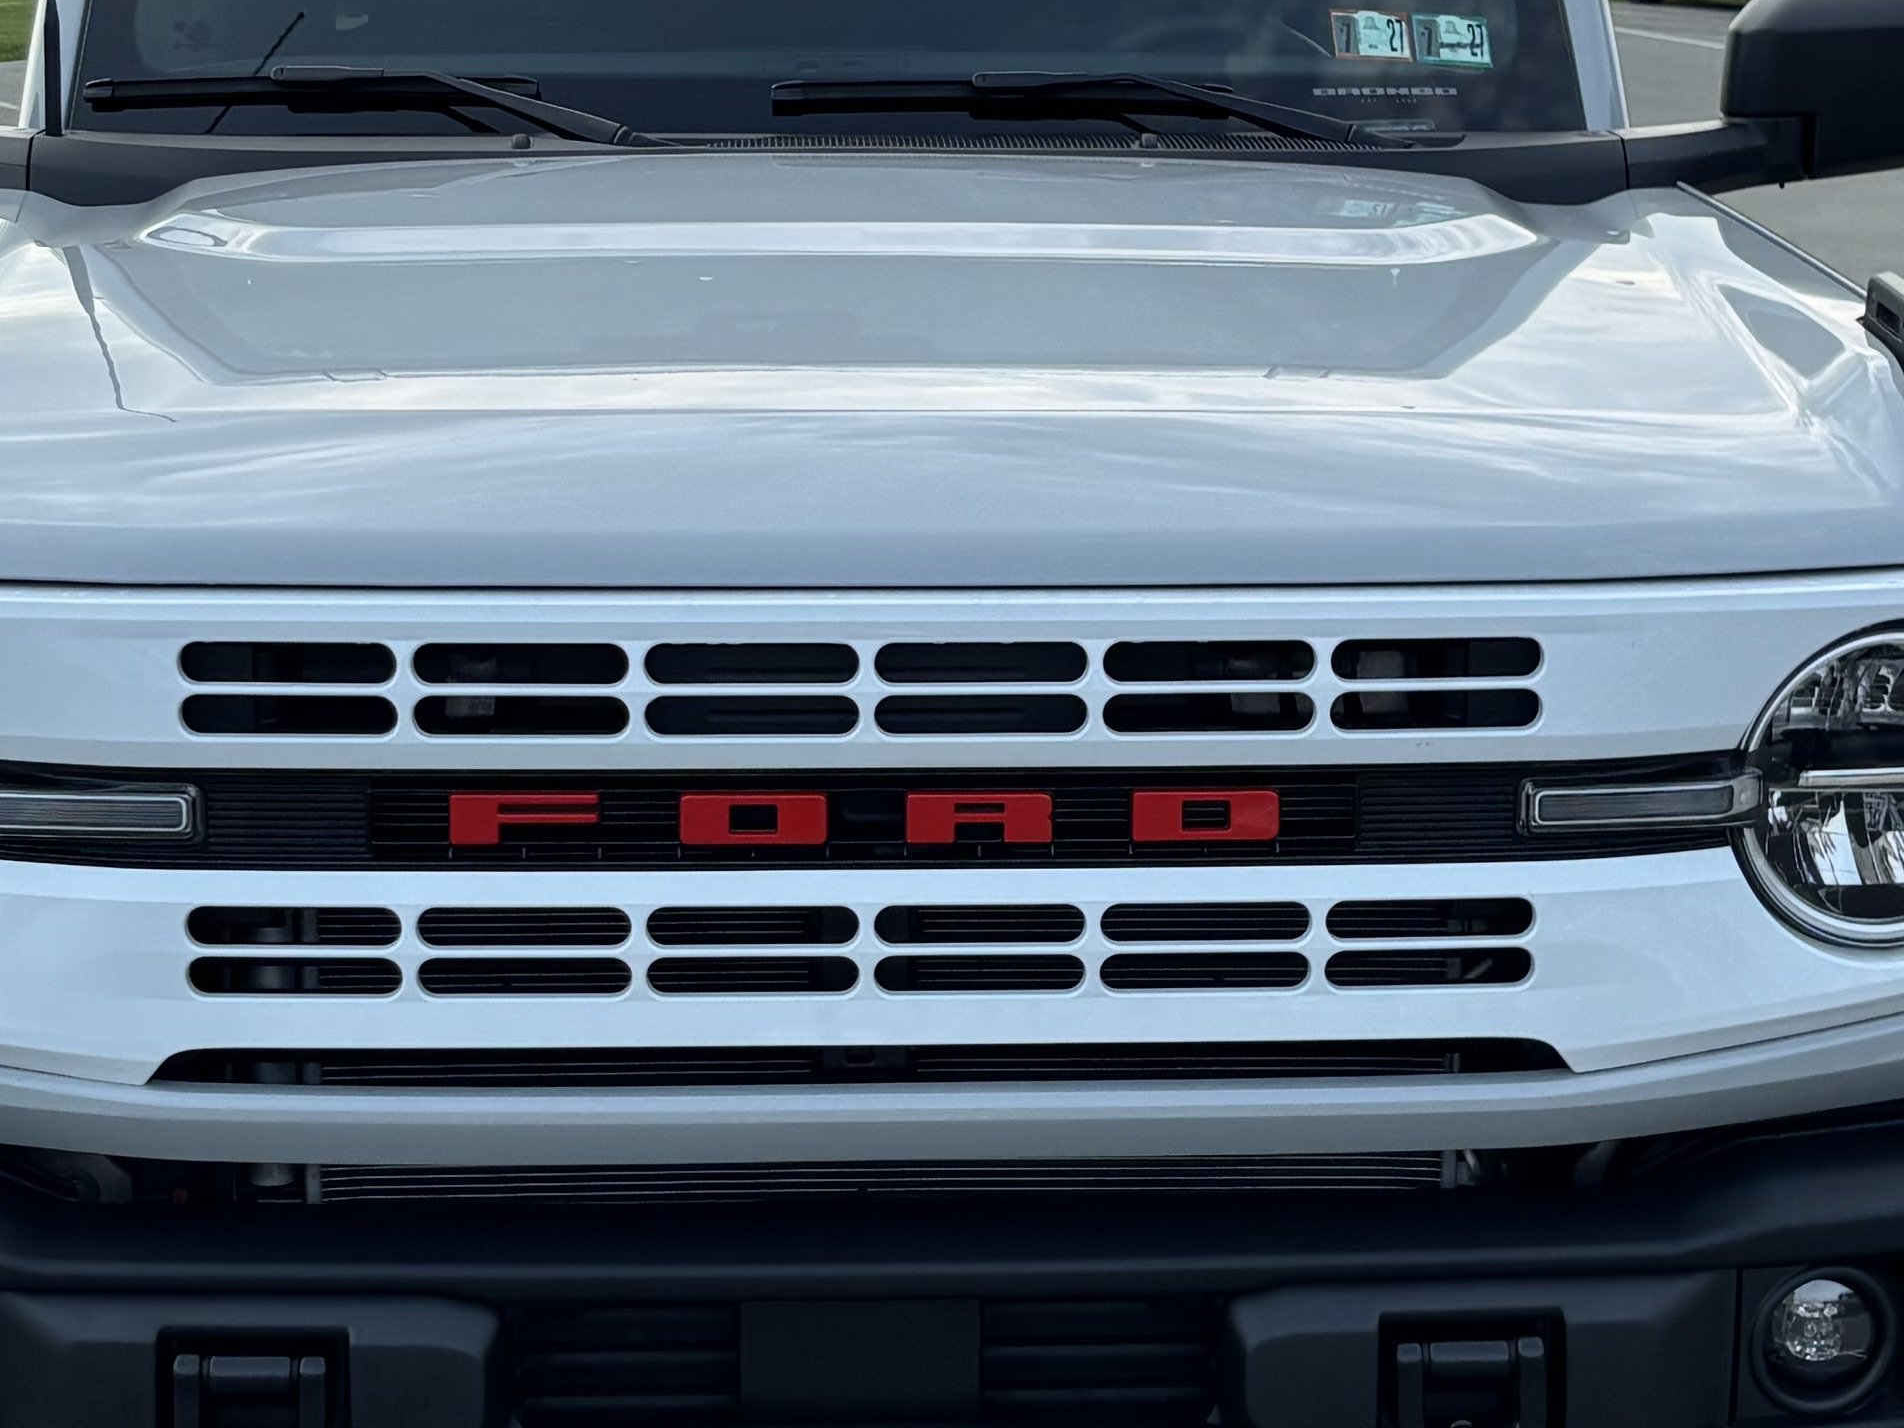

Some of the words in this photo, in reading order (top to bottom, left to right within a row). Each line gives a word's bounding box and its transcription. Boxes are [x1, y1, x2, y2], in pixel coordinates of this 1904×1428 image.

[1386, 18, 1404, 56] 27
[1467, 23, 1485, 60] 27
[448, 788, 1281, 846] FORD
